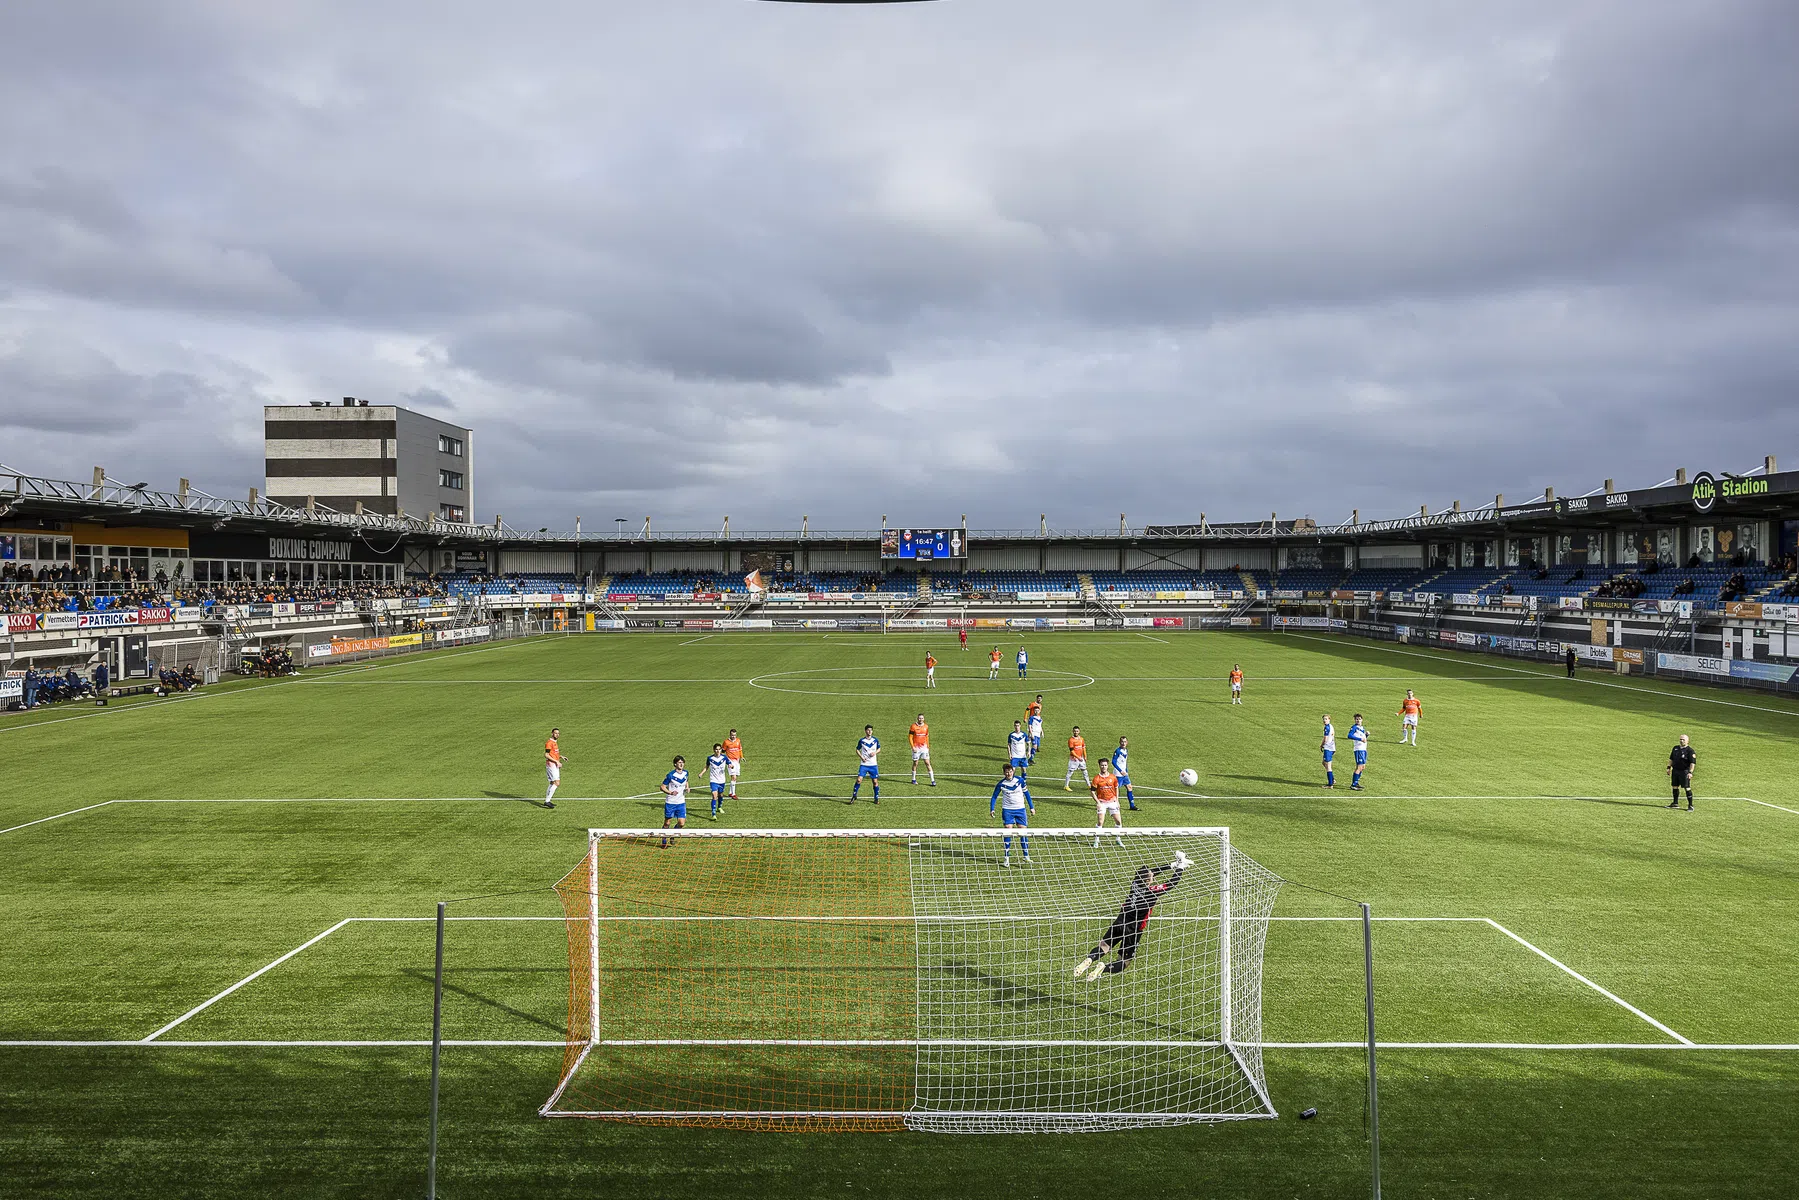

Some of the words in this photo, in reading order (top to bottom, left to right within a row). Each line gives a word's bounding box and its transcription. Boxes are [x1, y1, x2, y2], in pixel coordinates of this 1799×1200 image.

[1692, 484, 1715, 500] Atik
[1722, 478, 1768, 497] Stadion
[1568, 499, 1588, 509] SAKKO
[1606, 494, 1628, 504] SAKKO
[309, 540, 352, 560] COMPANY
[906, 543, 910, 551] 1
[937, 543, 943, 551] 0
[47, 615, 77, 624] Vermetten
[89, 614, 124, 625] PATRICK
[142, 609, 166, 620] SAKKO
[332, 644, 344, 654] ING
[352, 642, 364, 652] ING
[371, 640, 382, 649] ING
[1697, 658, 1723, 670] SELECT
